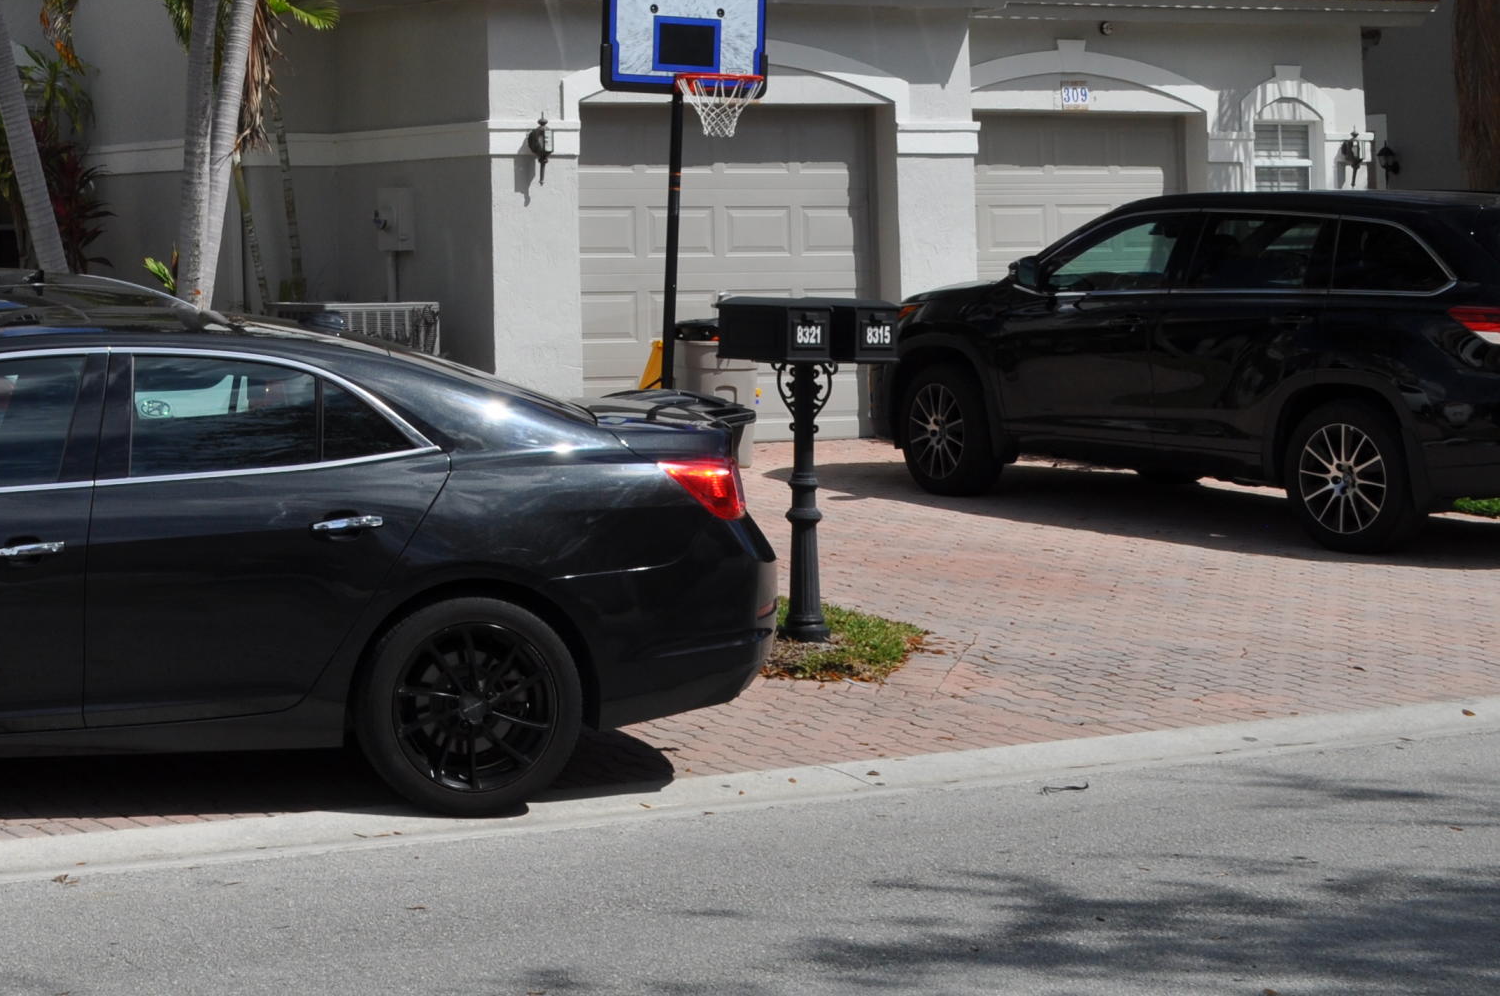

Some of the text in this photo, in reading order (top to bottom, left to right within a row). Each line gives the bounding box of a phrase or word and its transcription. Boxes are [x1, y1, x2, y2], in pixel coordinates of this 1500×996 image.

[1063, 87, 1088, 103] 309
[797, 325, 821, 344] 8321
[867, 325, 891, 344] 8315
